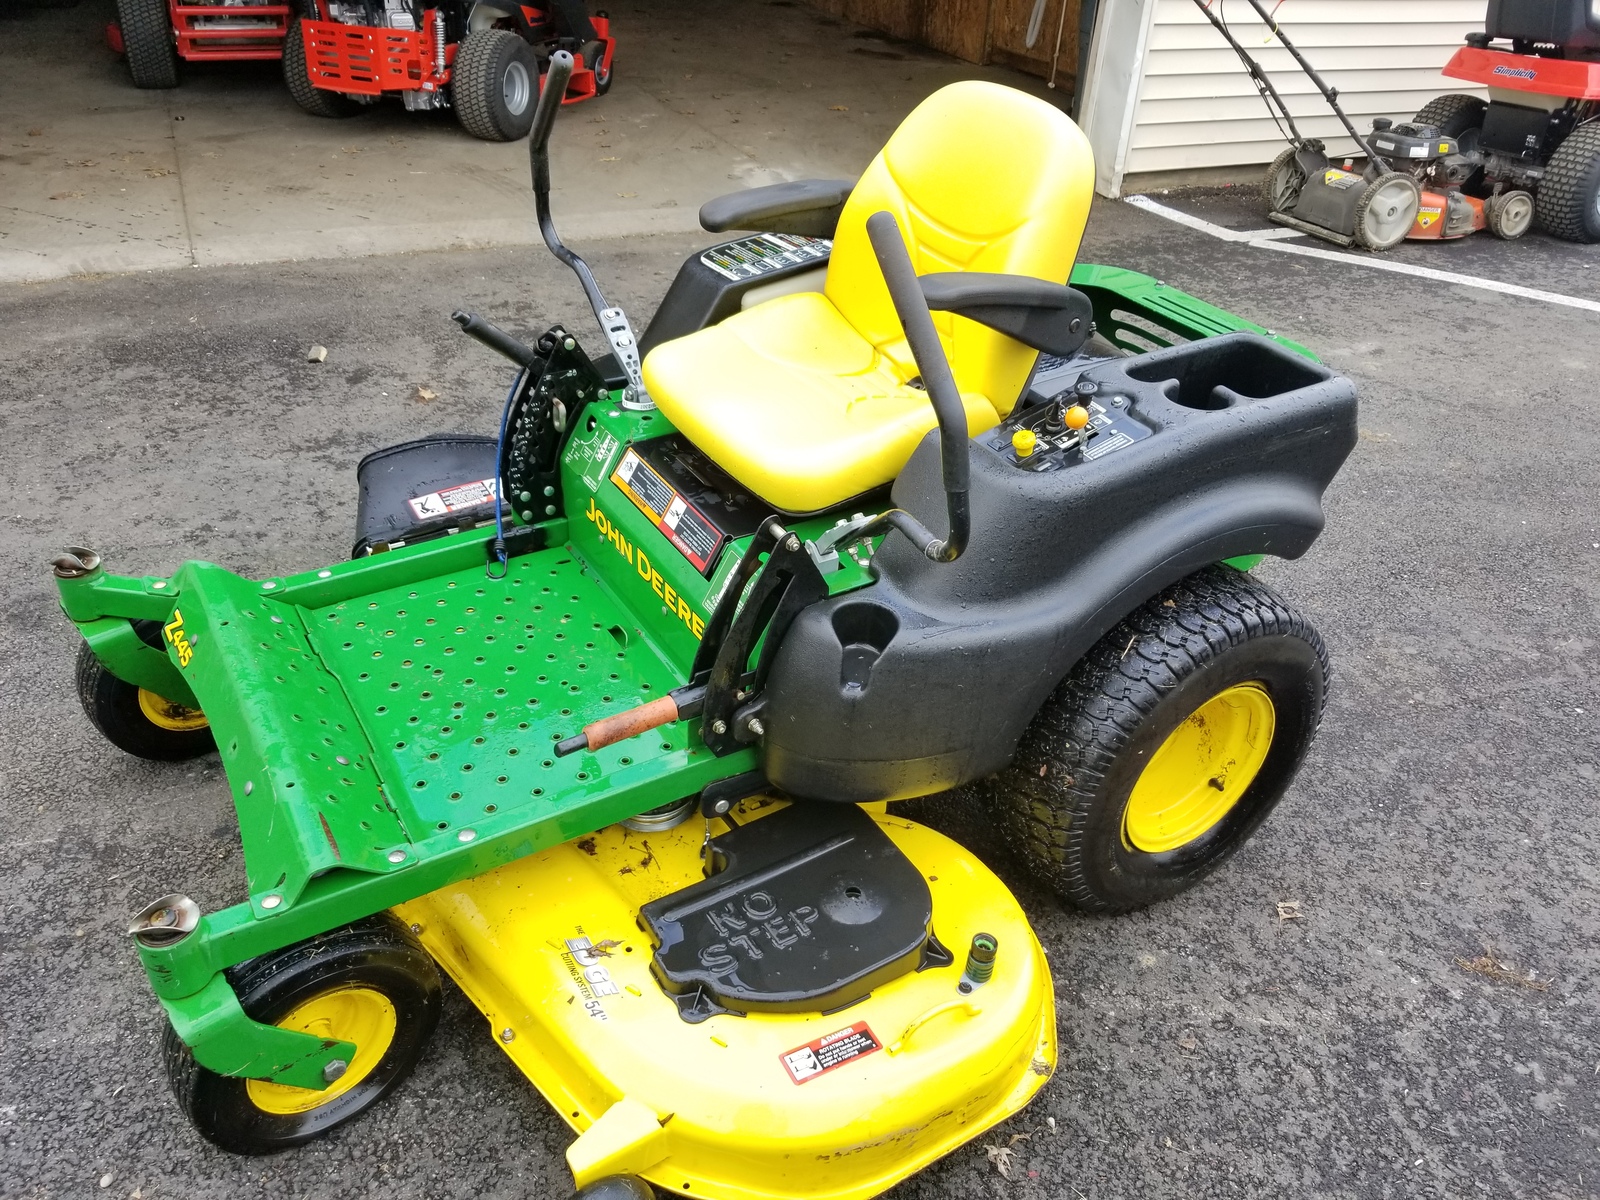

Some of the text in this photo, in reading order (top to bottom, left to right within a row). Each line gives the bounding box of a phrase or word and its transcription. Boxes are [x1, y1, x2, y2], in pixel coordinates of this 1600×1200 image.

[1493, 65, 1536, 80] Simplicity
[585, 497, 633, 565] JOHN
[637, 547, 706, 641] DEERE
[164, 608, 193, 668] Z445
[575, 925, 585, 935] THE
[706, 890, 778, 938] NO
[564, 936, 619, 998] EDGE
[698, 906, 819, 977] STEP
[561, 952, 608, 1021] CUTTING SYSTEM 54"
[819, 1033, 861, 1054] ROTATING BLADE
[826, 1027, 854, 1042] DANGER
